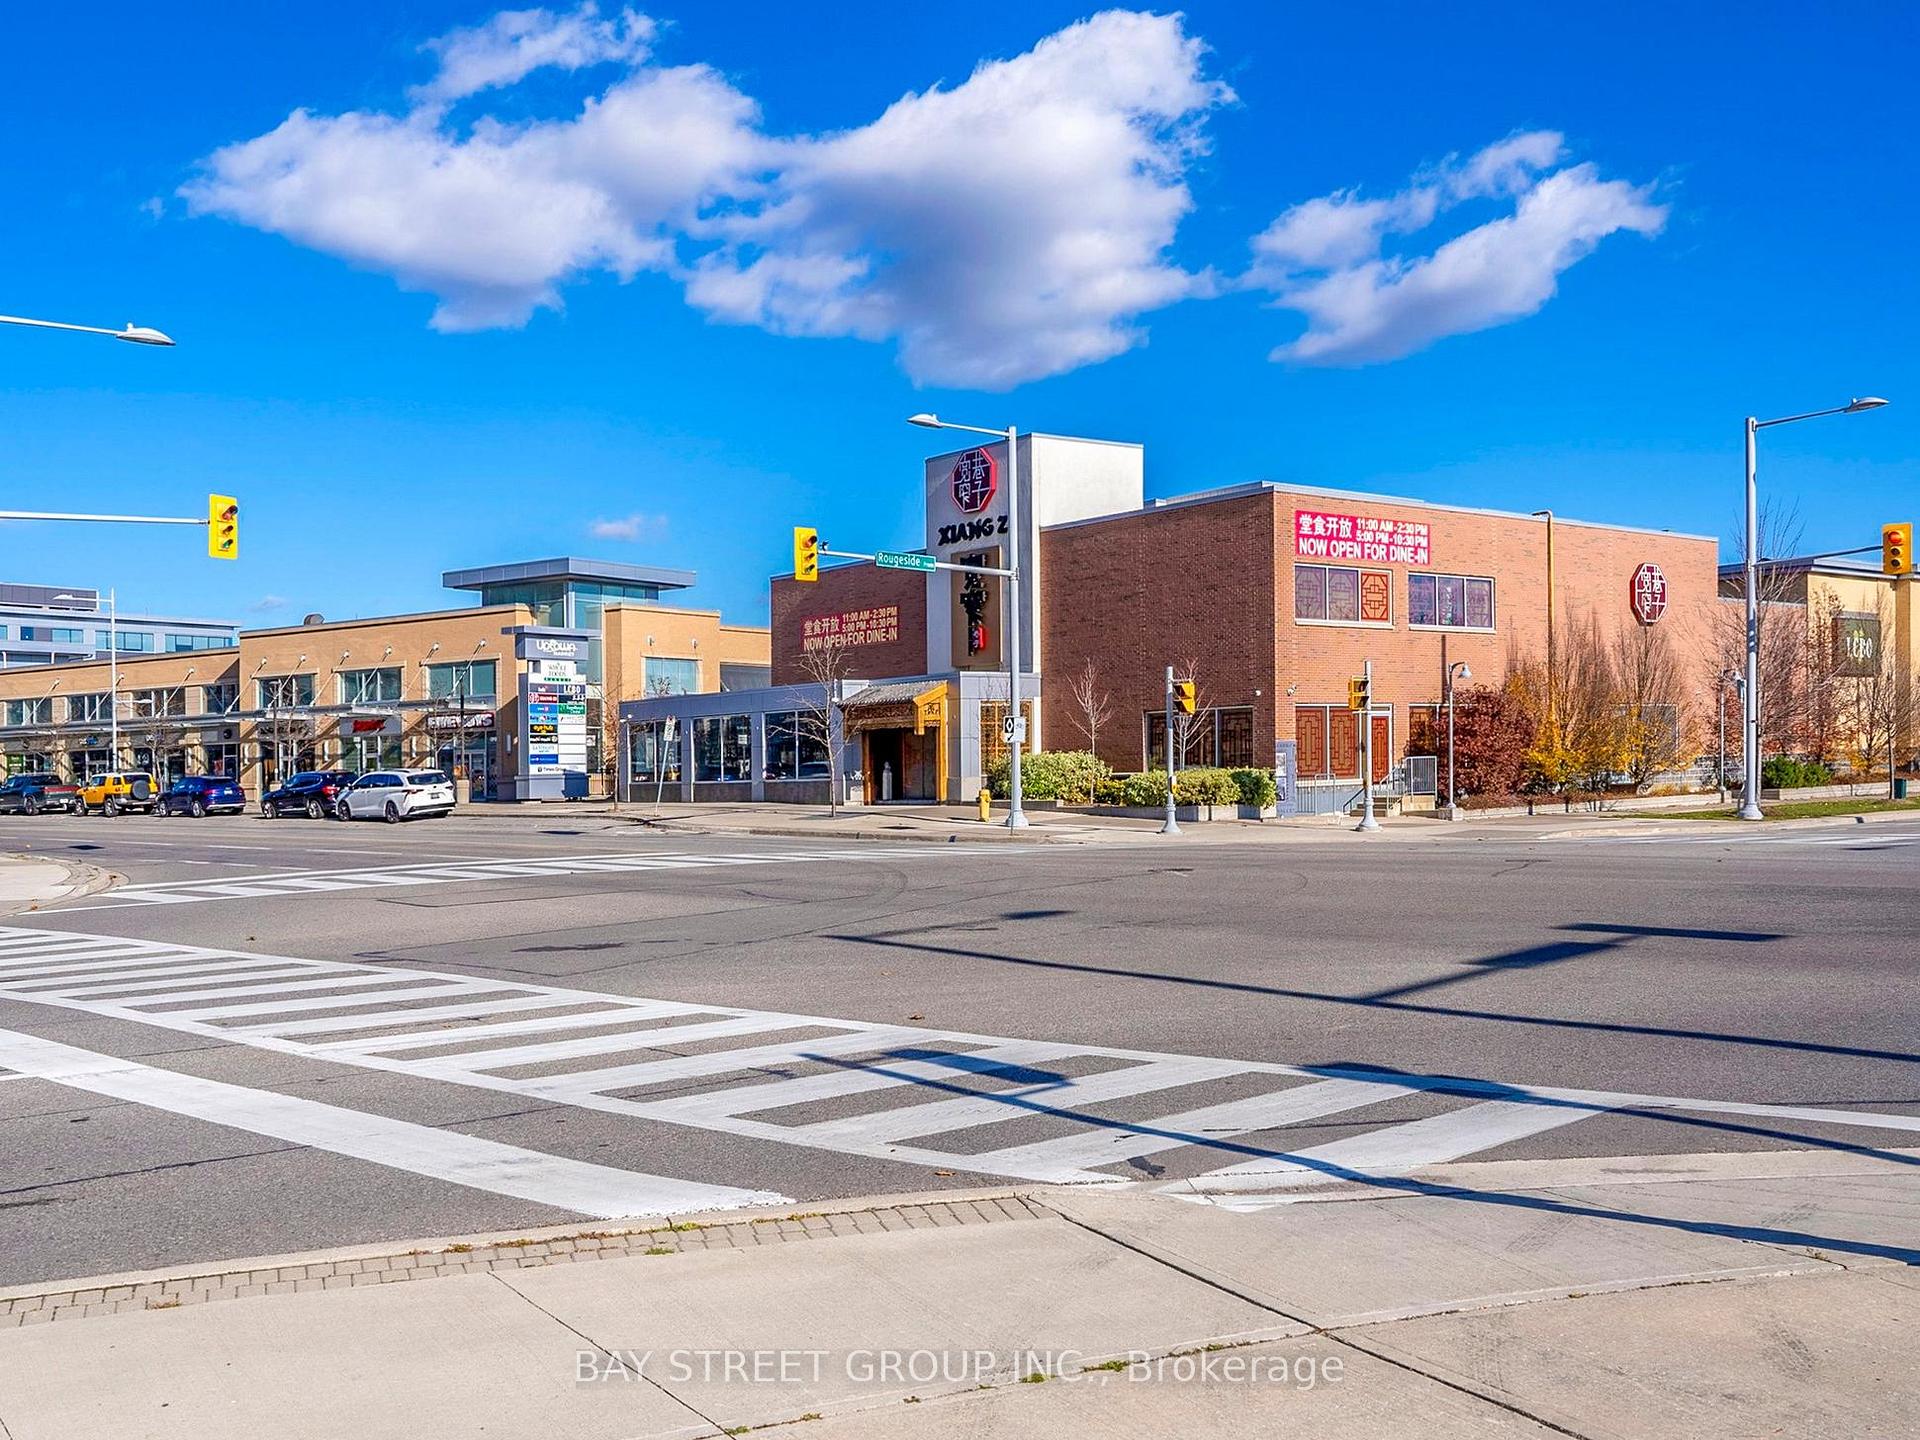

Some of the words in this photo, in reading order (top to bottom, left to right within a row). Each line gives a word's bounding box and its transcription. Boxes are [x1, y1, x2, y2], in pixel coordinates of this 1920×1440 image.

[938, 517, 995, 546] XIANG
[1299, 514, 1352, 538] 堂食开放
[1357, 518, 1378, 530] 11:00
[1415, 524, 1428, 535] PM
[1356, 530, 1374, 542] 5:00
[1415, 535, 1428, 547] PM
[1299, 537, 1327, 556] NOW
[1330, 540, 1361, 559] OPEN
[1364, 543, 1388, 561] FOR
[1389, 545, 1428, 564] DINE-IN
[878, 552, 920, 567] Rougeside
[842, 612, 858, 623] 11:00
[887, 606, 897, 616] PM
[842, 622, 855, 633] 5:00
[887, 617, 897, 627] PM
[803, 636, 823, 651] NOW
[824, 632, 846, 648] OPEN
[847, 631, 865, 646] FOR
[866, 627, 898, 643] DINE-IN
